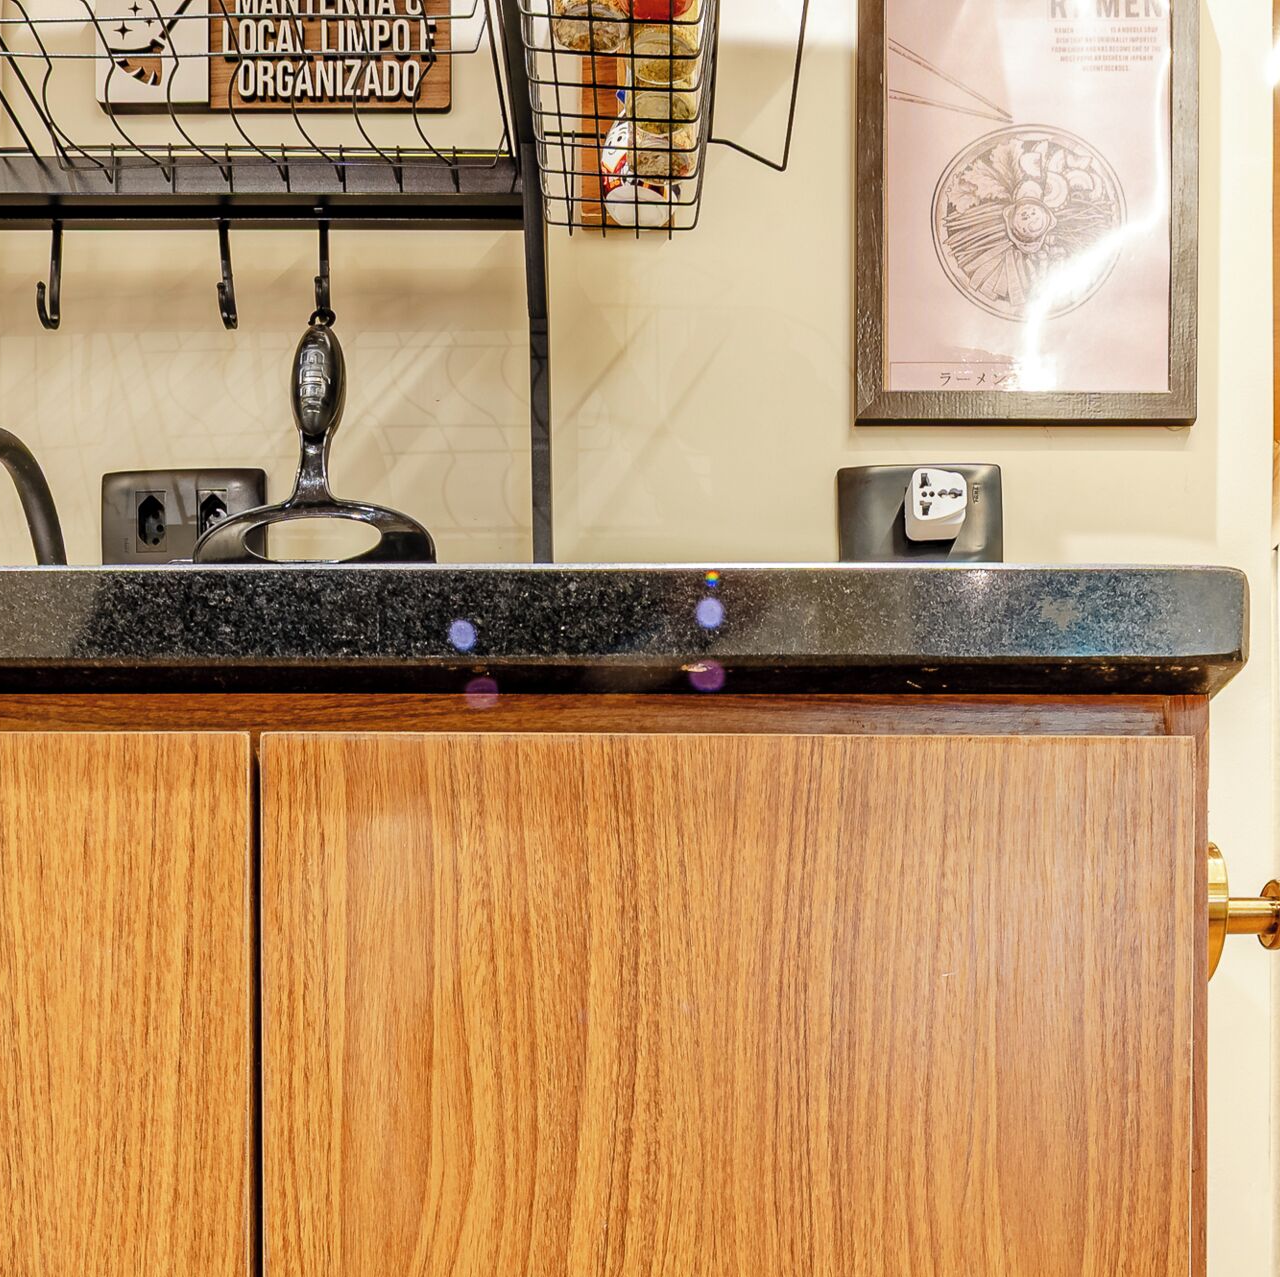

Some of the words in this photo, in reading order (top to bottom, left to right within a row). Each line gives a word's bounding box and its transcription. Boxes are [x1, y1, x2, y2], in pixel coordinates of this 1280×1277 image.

[1050, 0, 1162, 18] RMEN
[222, 19, 311, 53] LOCAL
[321, 19, 414, 53] LIMPO
[420, 19, 436, 53] E
[237, 59, 420, 97] ORGANIZADO
